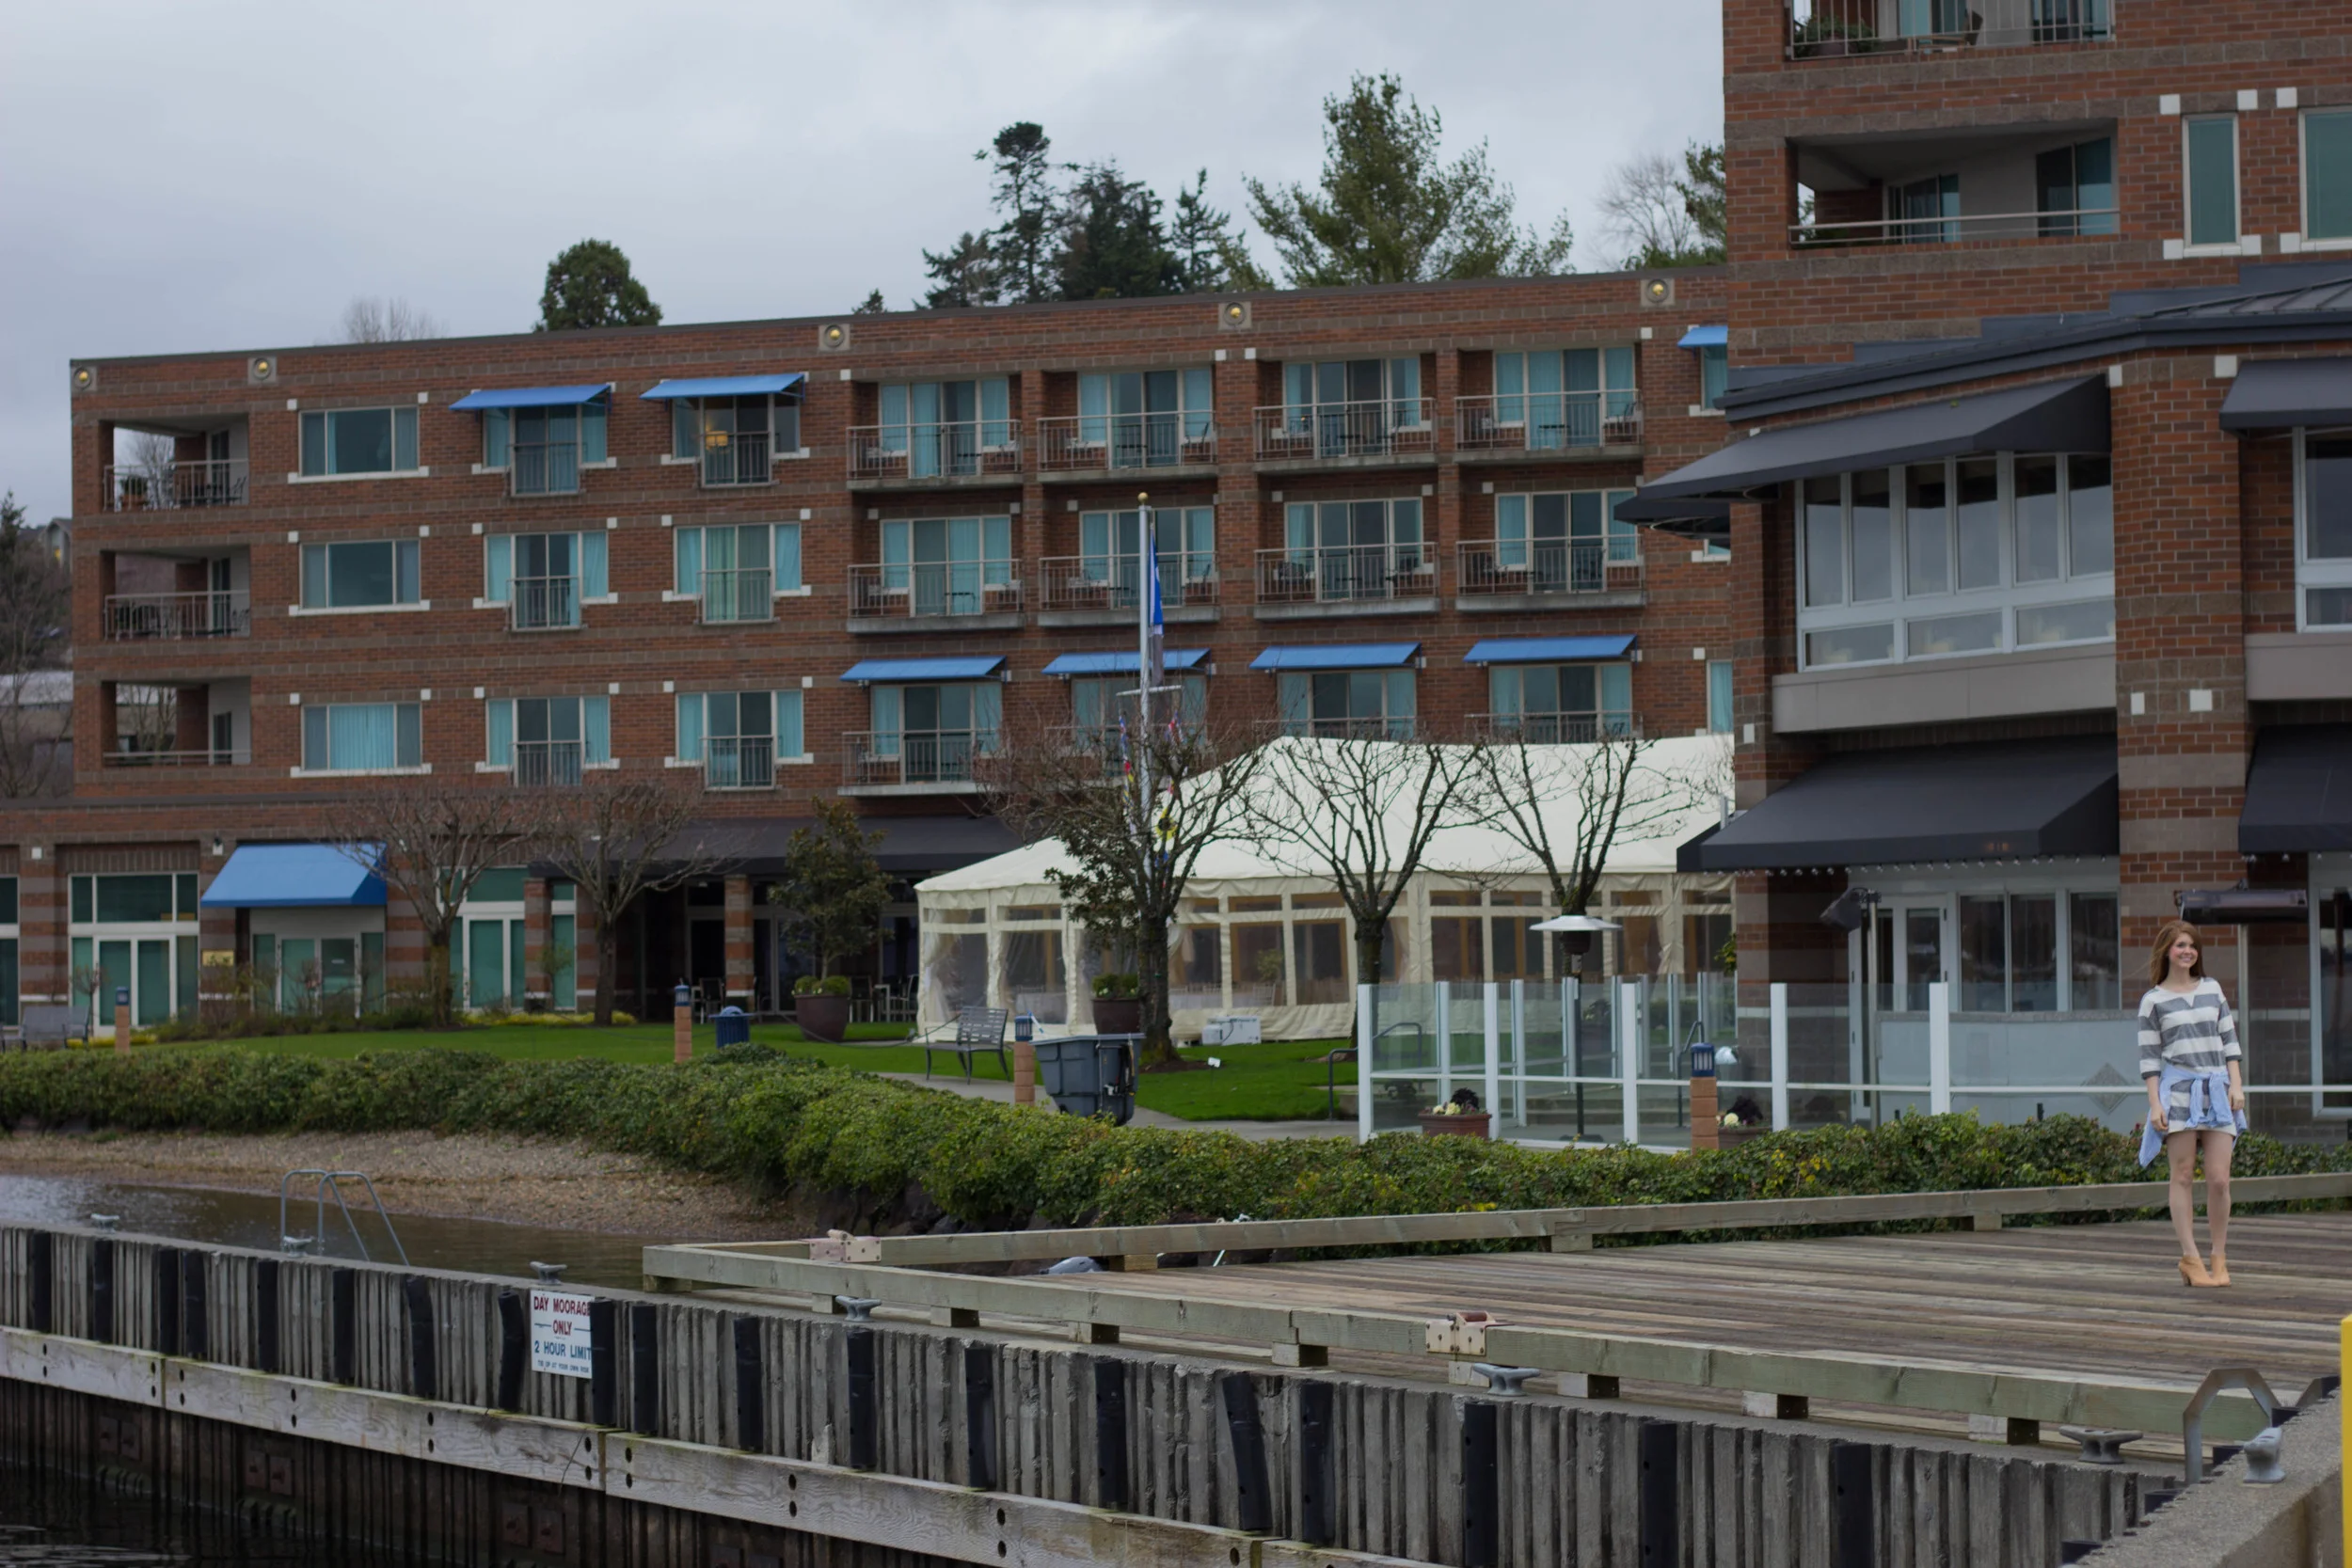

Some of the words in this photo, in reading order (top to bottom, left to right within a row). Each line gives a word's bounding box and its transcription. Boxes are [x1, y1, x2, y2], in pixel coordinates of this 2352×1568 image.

[533, 1296, 548, 1311] DAY
[553, 1320, 572, 1336] ONLY
[534, 1340, 540, 1354] 2
[544, 1341, 566, 1356] HOUR
[570, 1344, 591, 1360] LIMIT
